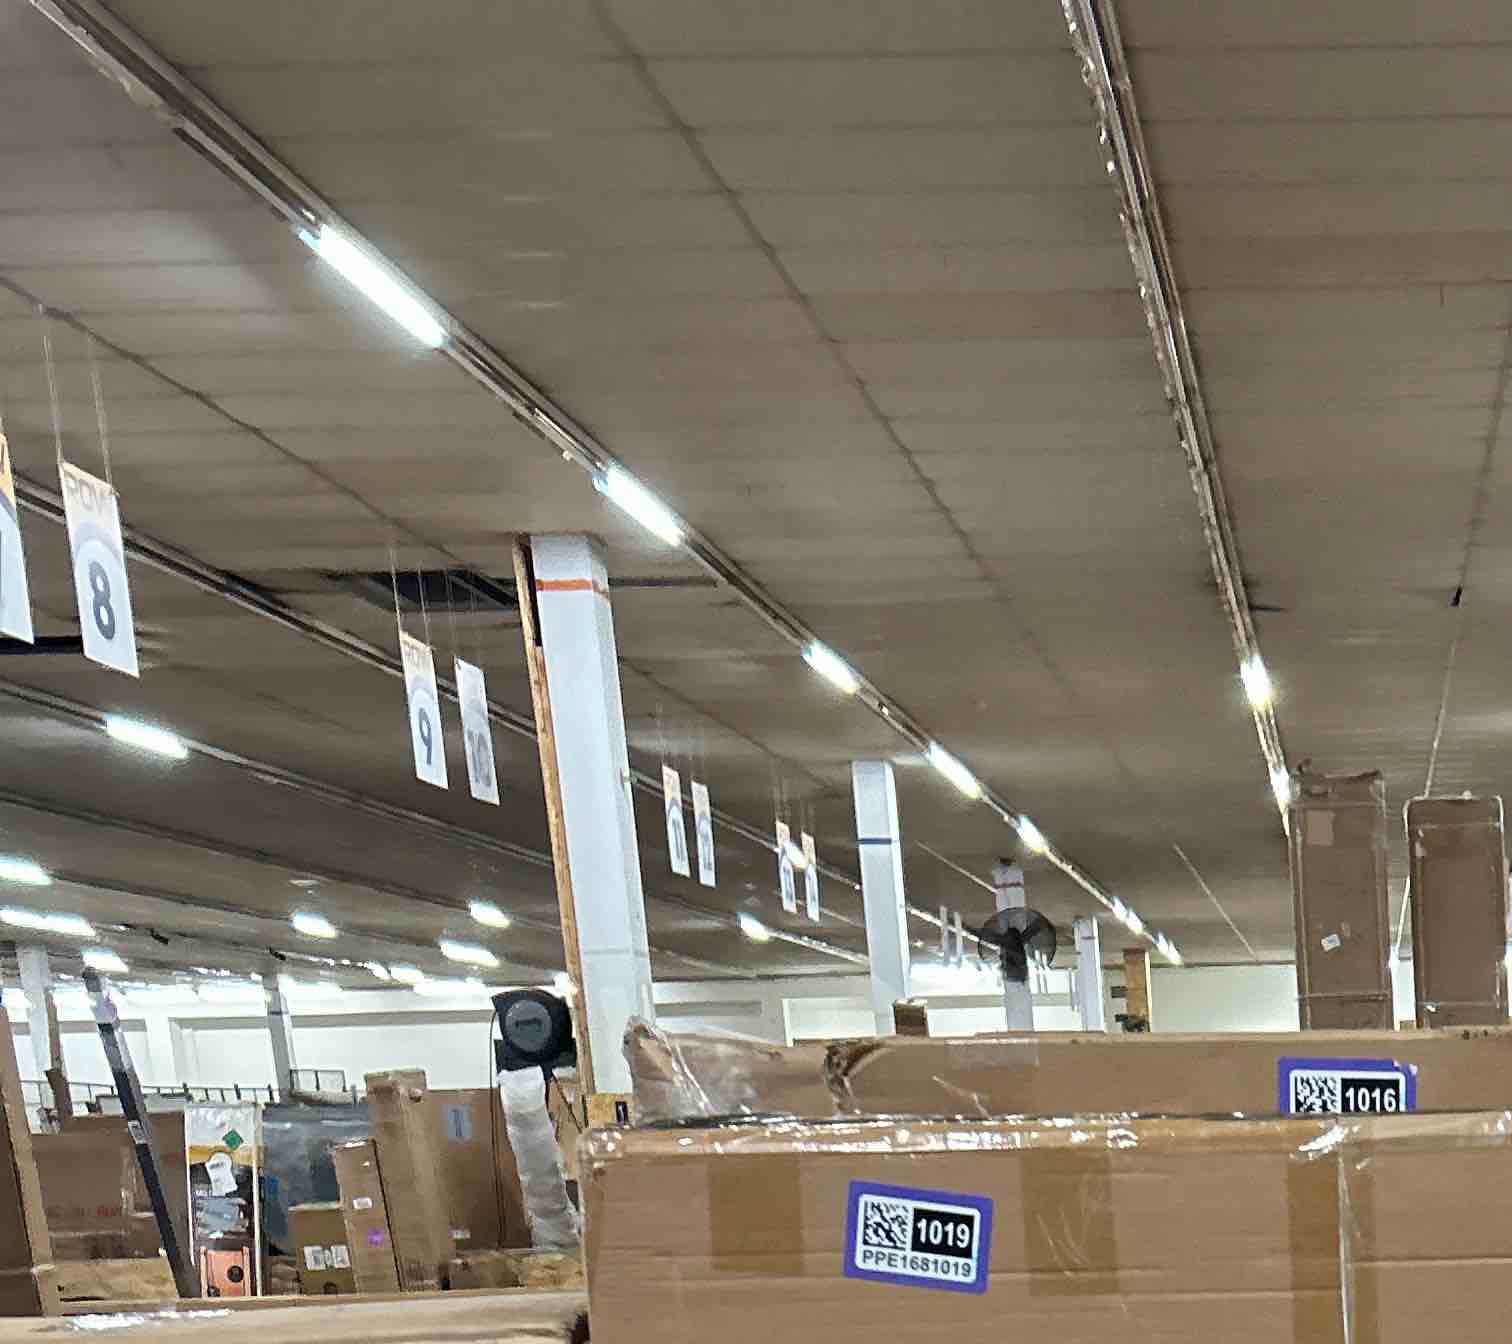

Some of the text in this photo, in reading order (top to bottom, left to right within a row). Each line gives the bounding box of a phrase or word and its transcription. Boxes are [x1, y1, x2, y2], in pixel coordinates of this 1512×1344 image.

[89, 560, 115, 640] 8
[418, 708, 432, 765] 9
[1344, 1086, 1397, 1112] 1016
[917, 1217, 971, 1249] 1019
[862, 1249, 972, 1278] PPE1681019
